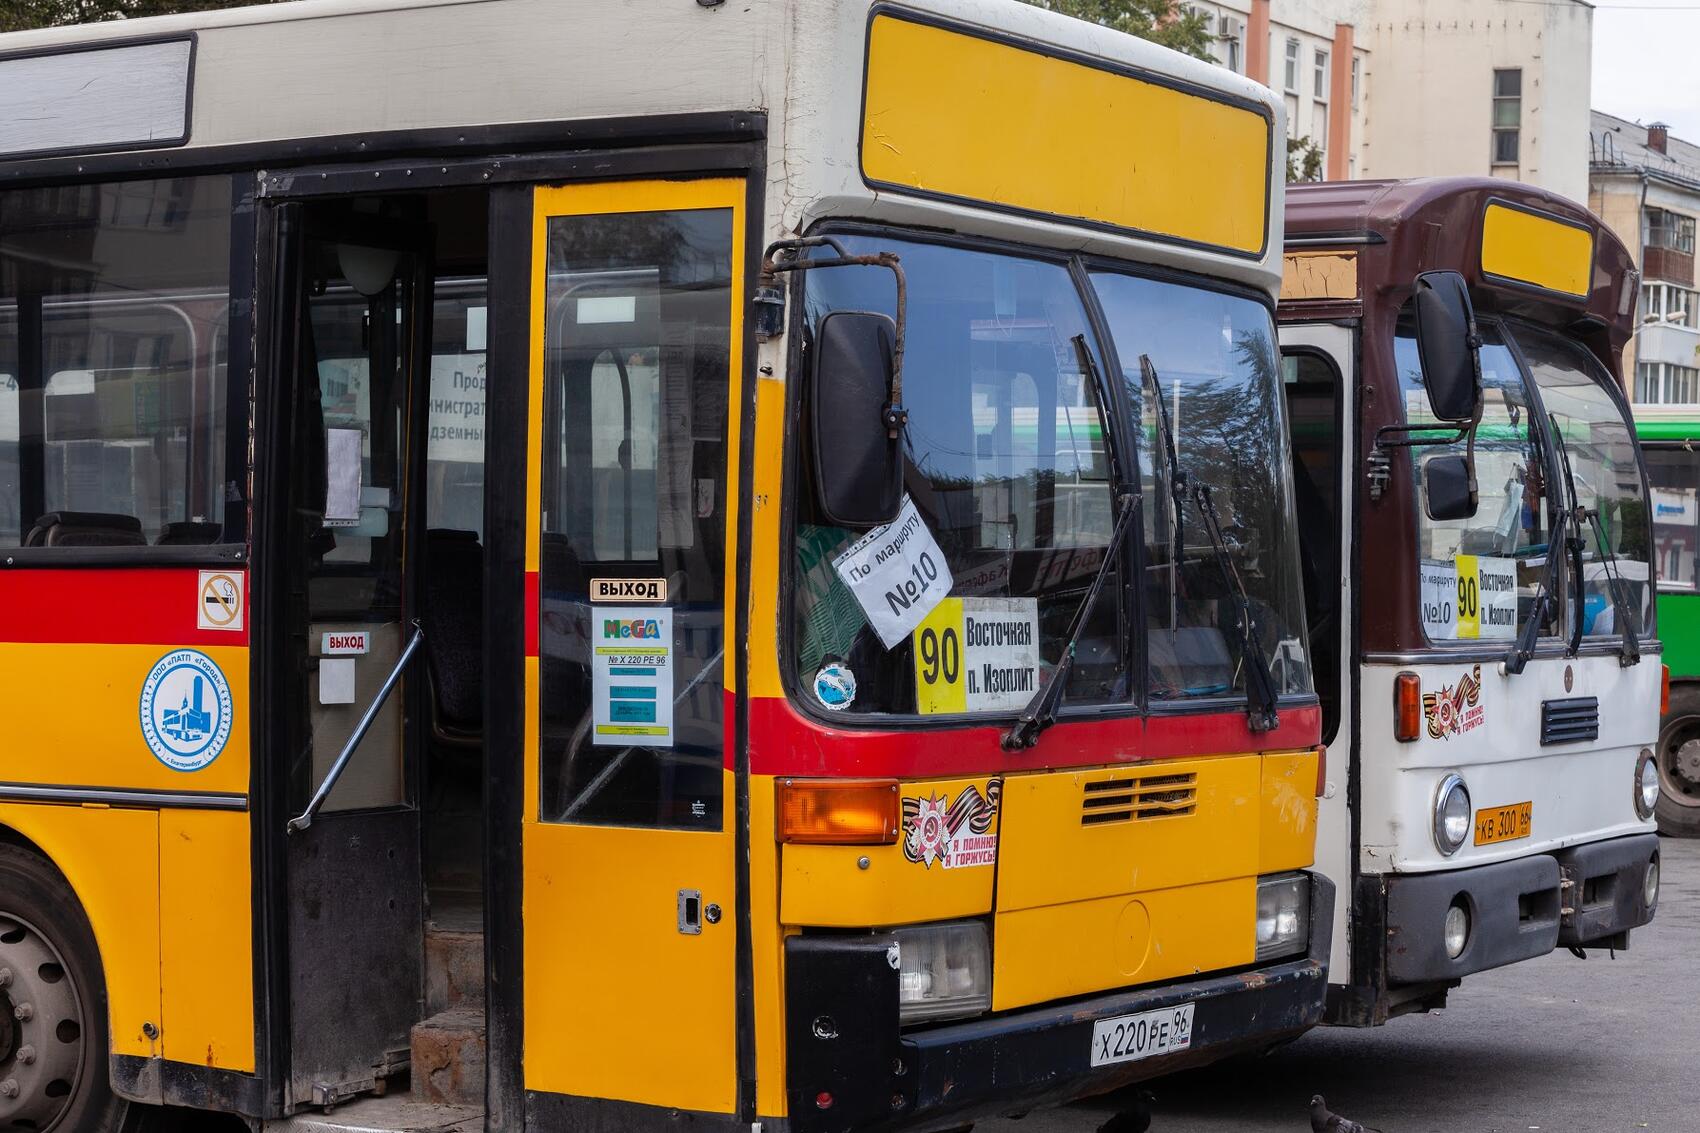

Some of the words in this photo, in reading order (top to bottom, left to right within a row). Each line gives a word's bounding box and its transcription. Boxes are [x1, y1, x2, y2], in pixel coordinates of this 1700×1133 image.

[849, 562, 871, 582] По
[875, 512, 920, 565] маршруту
[600, 582, 658, 598] ВЫХОД
[885, 551, 938, 617] №10
[1479, 569, 1514, 592] Восточная
[1458, 576, 1477, 618] 90
[329, 636, 364, 650] ВЫХОД
[966, 617, 1031, 647] Восточная
[628, 656, 641, 664] 220
[656, 656, 666, 665] 96
[920, 627, 959, 685] 90
[967, 669, 980, 694] п.
[983, 663, 1034, 693] Изоплит
[1498, 809, 1516, 836] 300
[953, 838, 960, 852] Я
[945, 853, 952, 867] Я
[1174, 1008, 1187, 1036] 96
